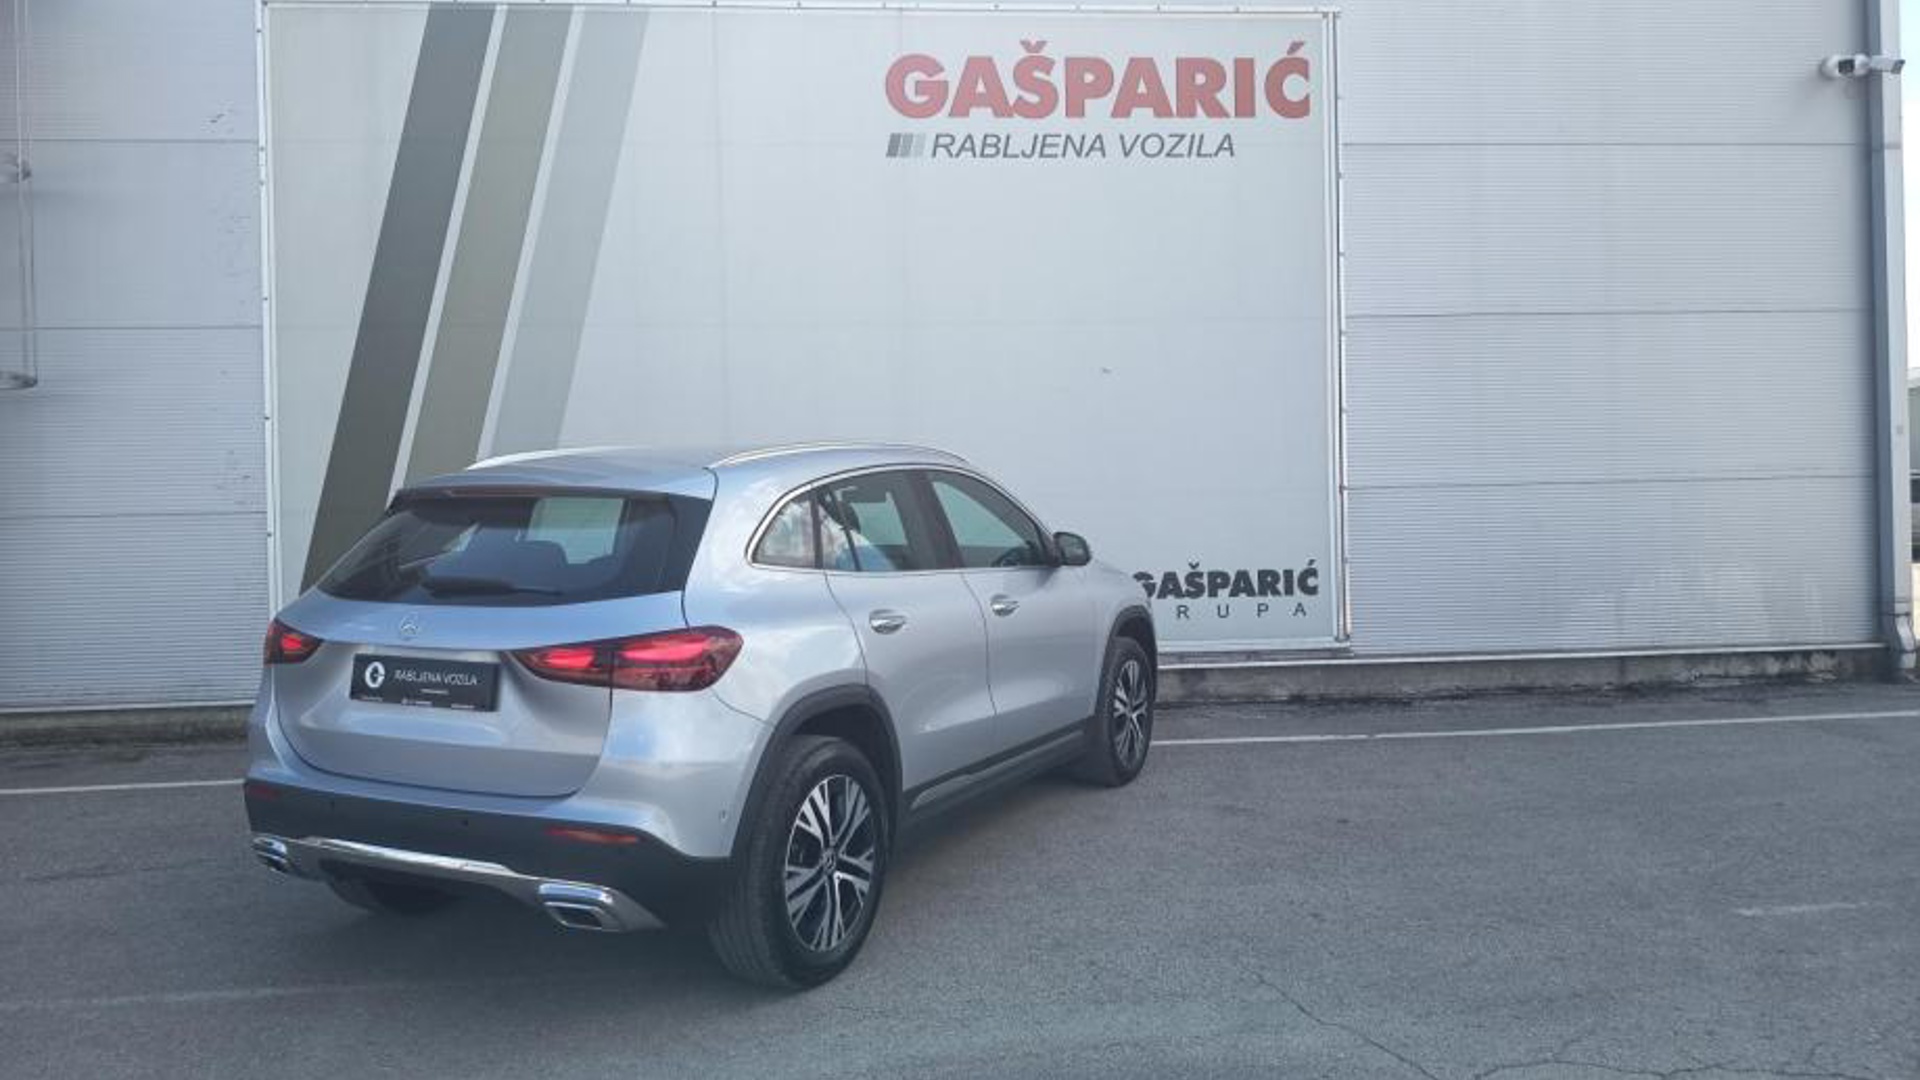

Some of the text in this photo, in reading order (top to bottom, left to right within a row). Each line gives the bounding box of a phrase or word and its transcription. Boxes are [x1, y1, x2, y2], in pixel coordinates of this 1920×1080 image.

[885, 40, 1310, 119] GAŠPARIĆ
[931, 134, 1236, 158] RABLJENA VOZILA
[1176, 603, 1306, 619] RUPA
